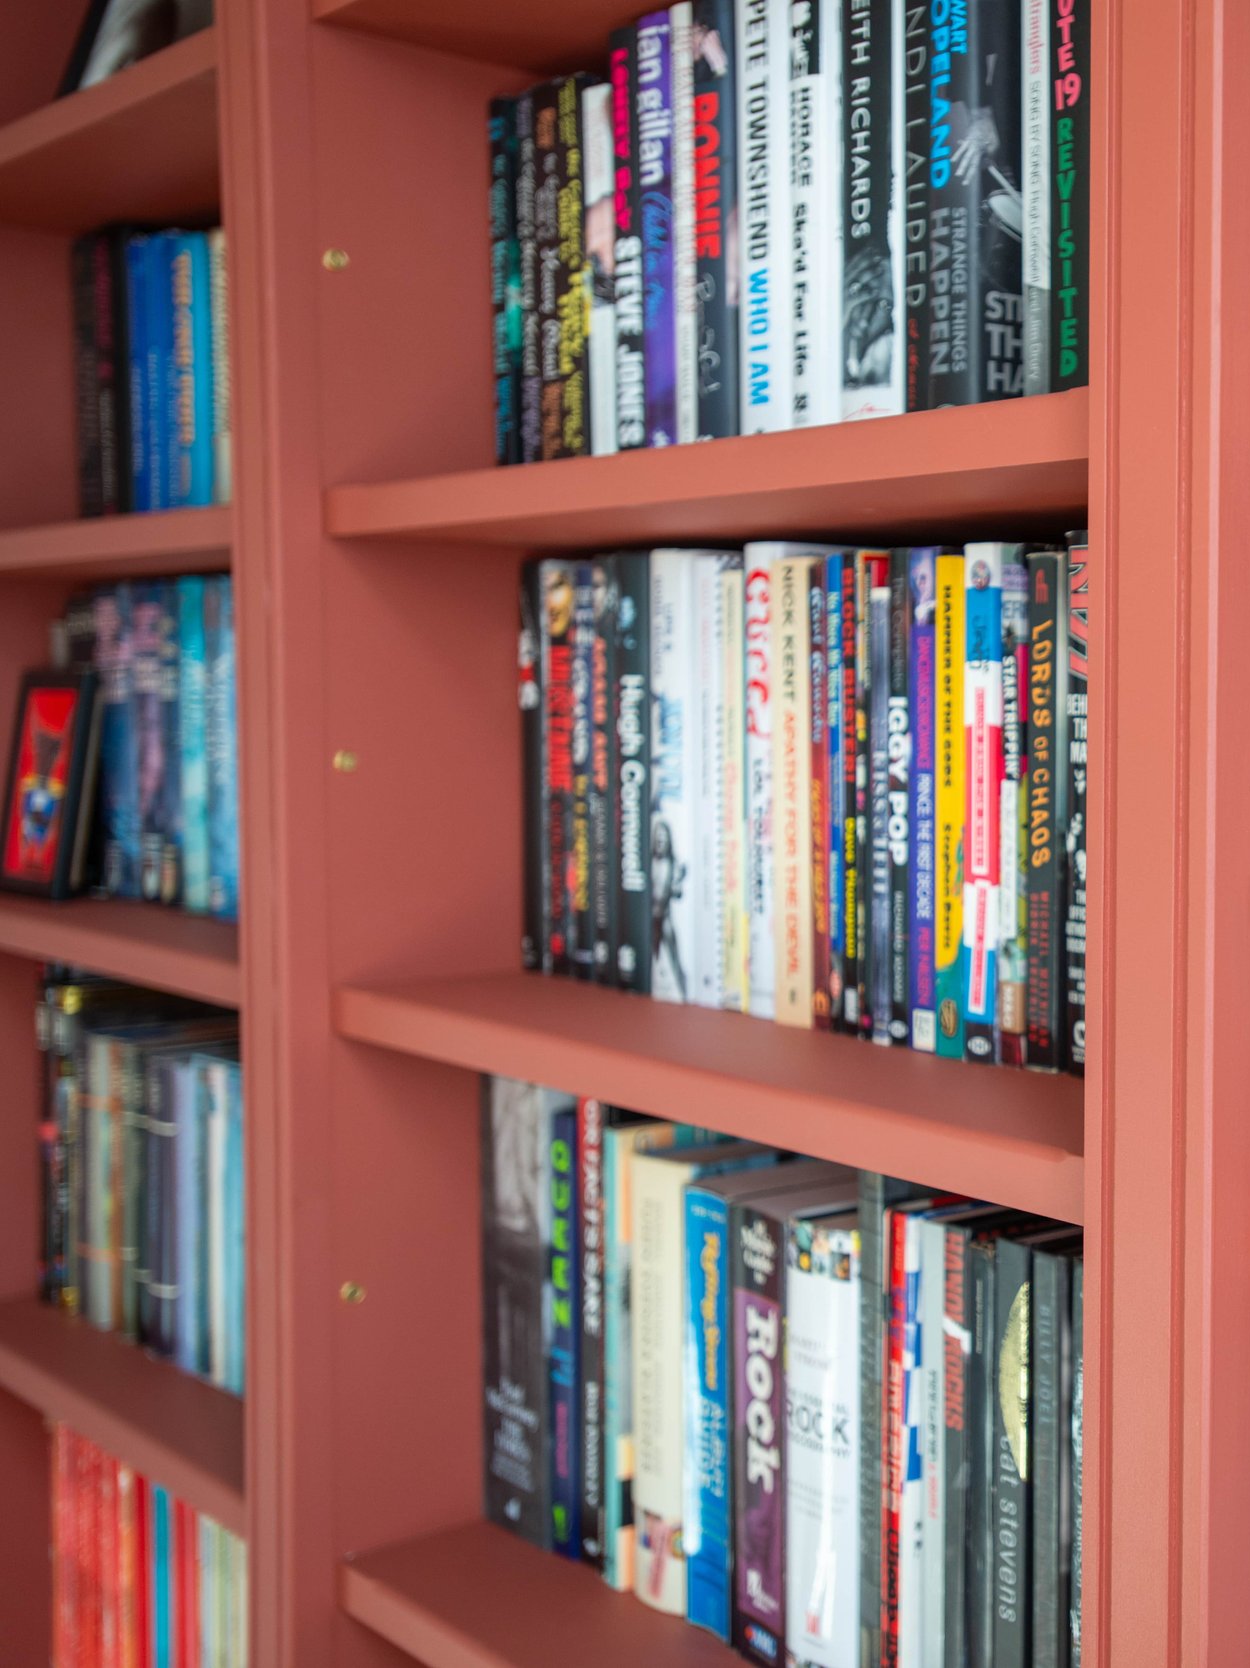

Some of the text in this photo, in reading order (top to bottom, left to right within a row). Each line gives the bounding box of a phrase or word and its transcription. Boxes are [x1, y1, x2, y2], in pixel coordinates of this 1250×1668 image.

[637, 86, 672, 187] gillan
[746, 0, 770, 408] PETE TOWNSHEND WHO AM
[850, 76, 872, 240] RICHARDS
[930, 206, 951, 376] HAPPEN
[950, 206, 968, 374] STRANGE THINGS
[1056, 118, 1079, 378] REVISITED
[615, 237, 644, 448] STEVE JONES
[1001, 656, 1020, 701] STAR
[1030, 620, 1054, 869] LORDS OF CHAOS
[618, 674, 647, 892] Hugh Cornwell
[887, 696, 910, 867] IGGY POP
[745, 1302, 782, 1496] Rock
[998, 1435, 1019, 1623] cat stevens
